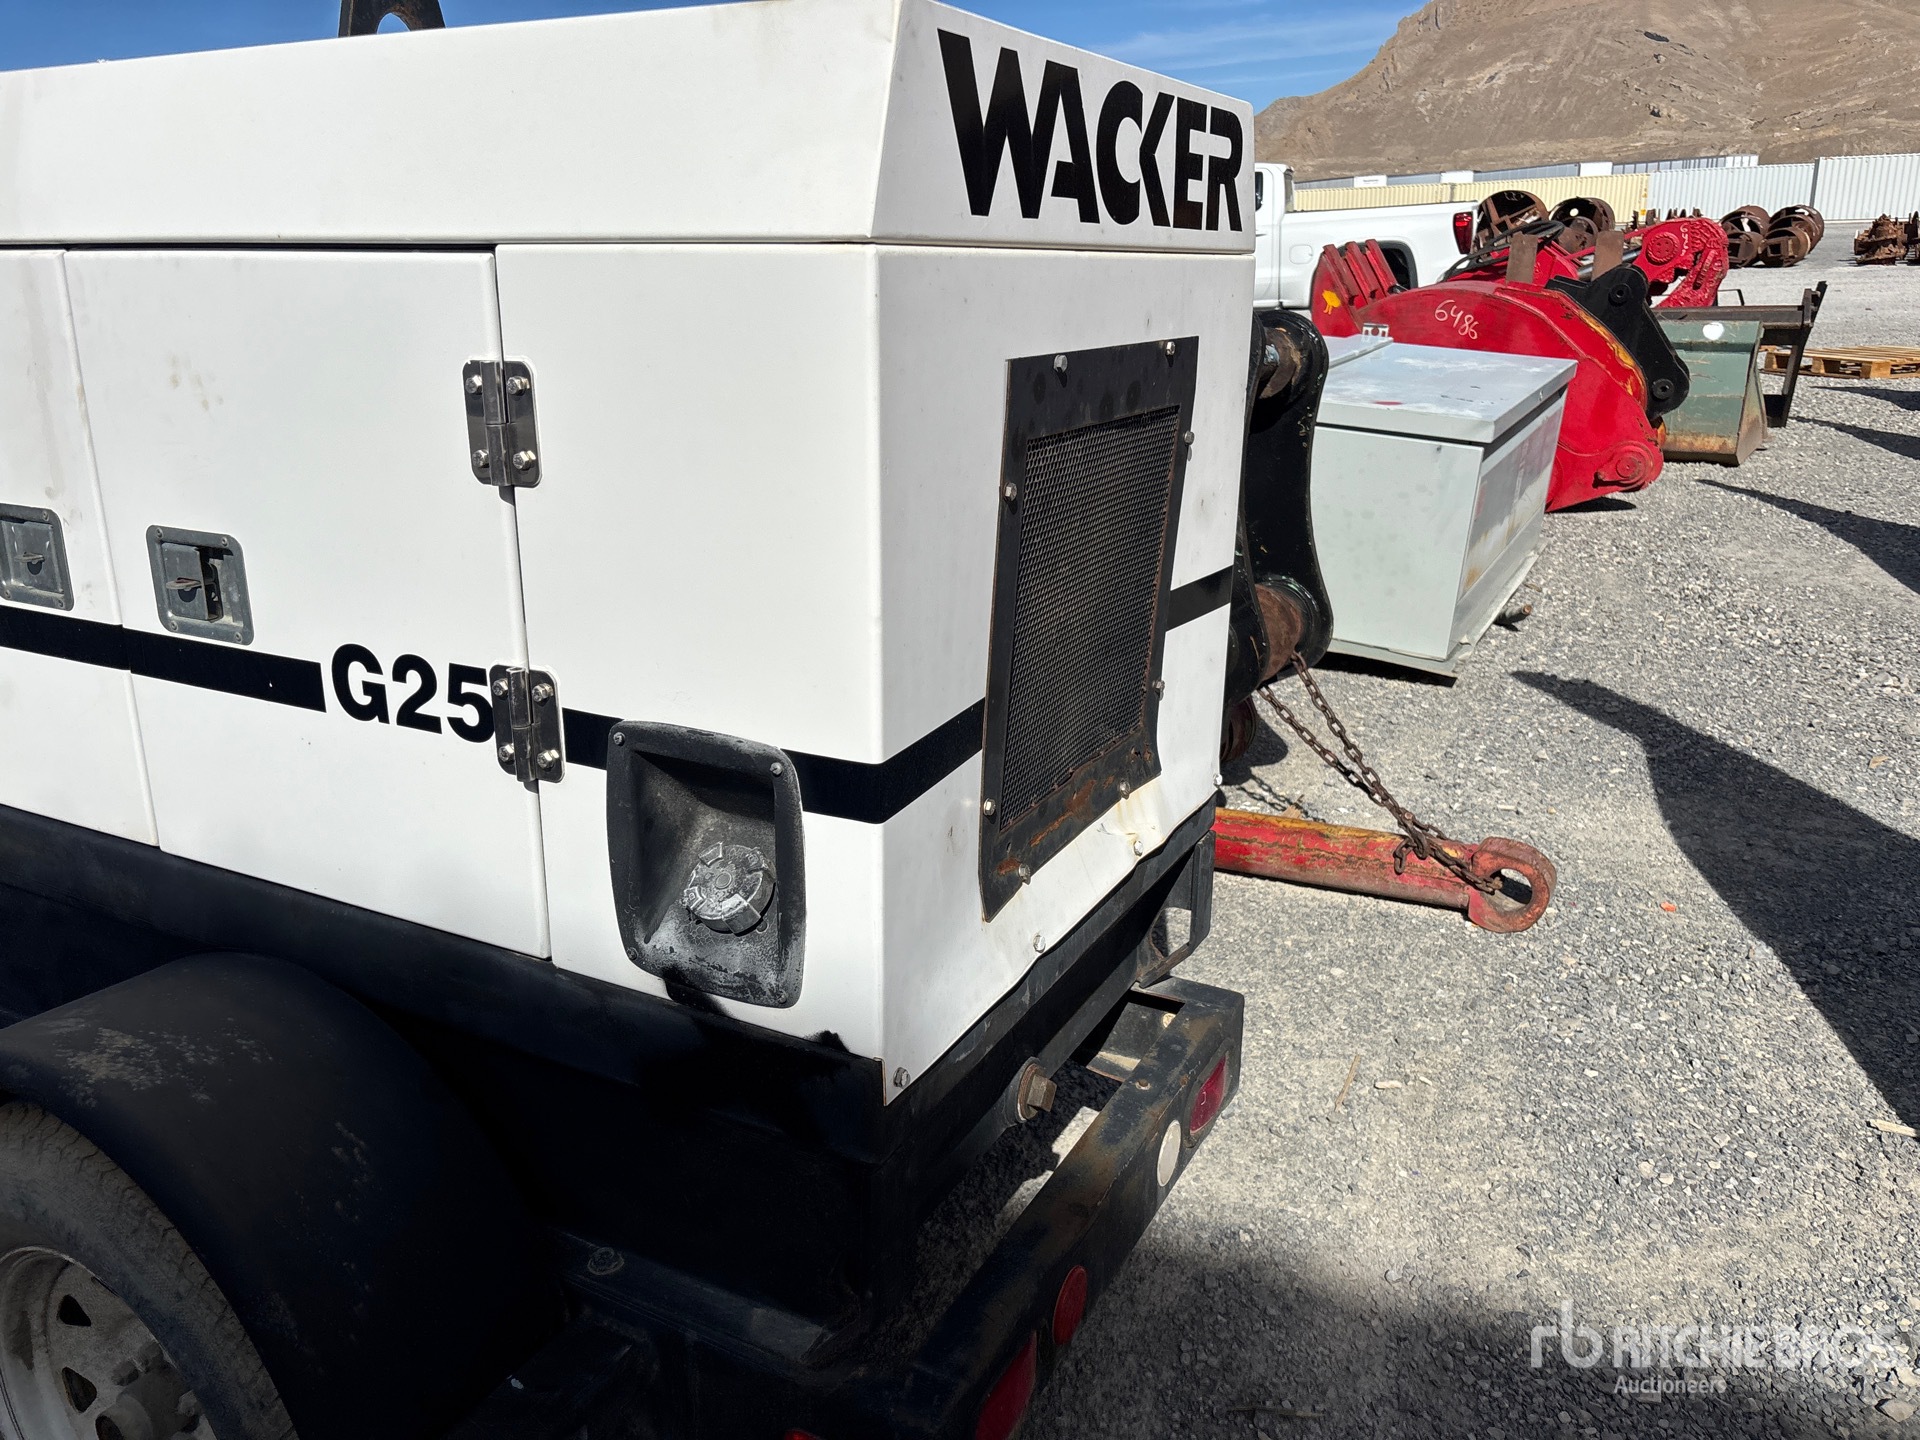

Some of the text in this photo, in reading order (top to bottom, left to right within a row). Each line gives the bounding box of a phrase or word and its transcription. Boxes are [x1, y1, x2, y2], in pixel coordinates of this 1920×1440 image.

[937, 28, 1243, 233] WACKER
[1434, 299, 1480, 340] 6486
[331, 643, 496, 744] G25
